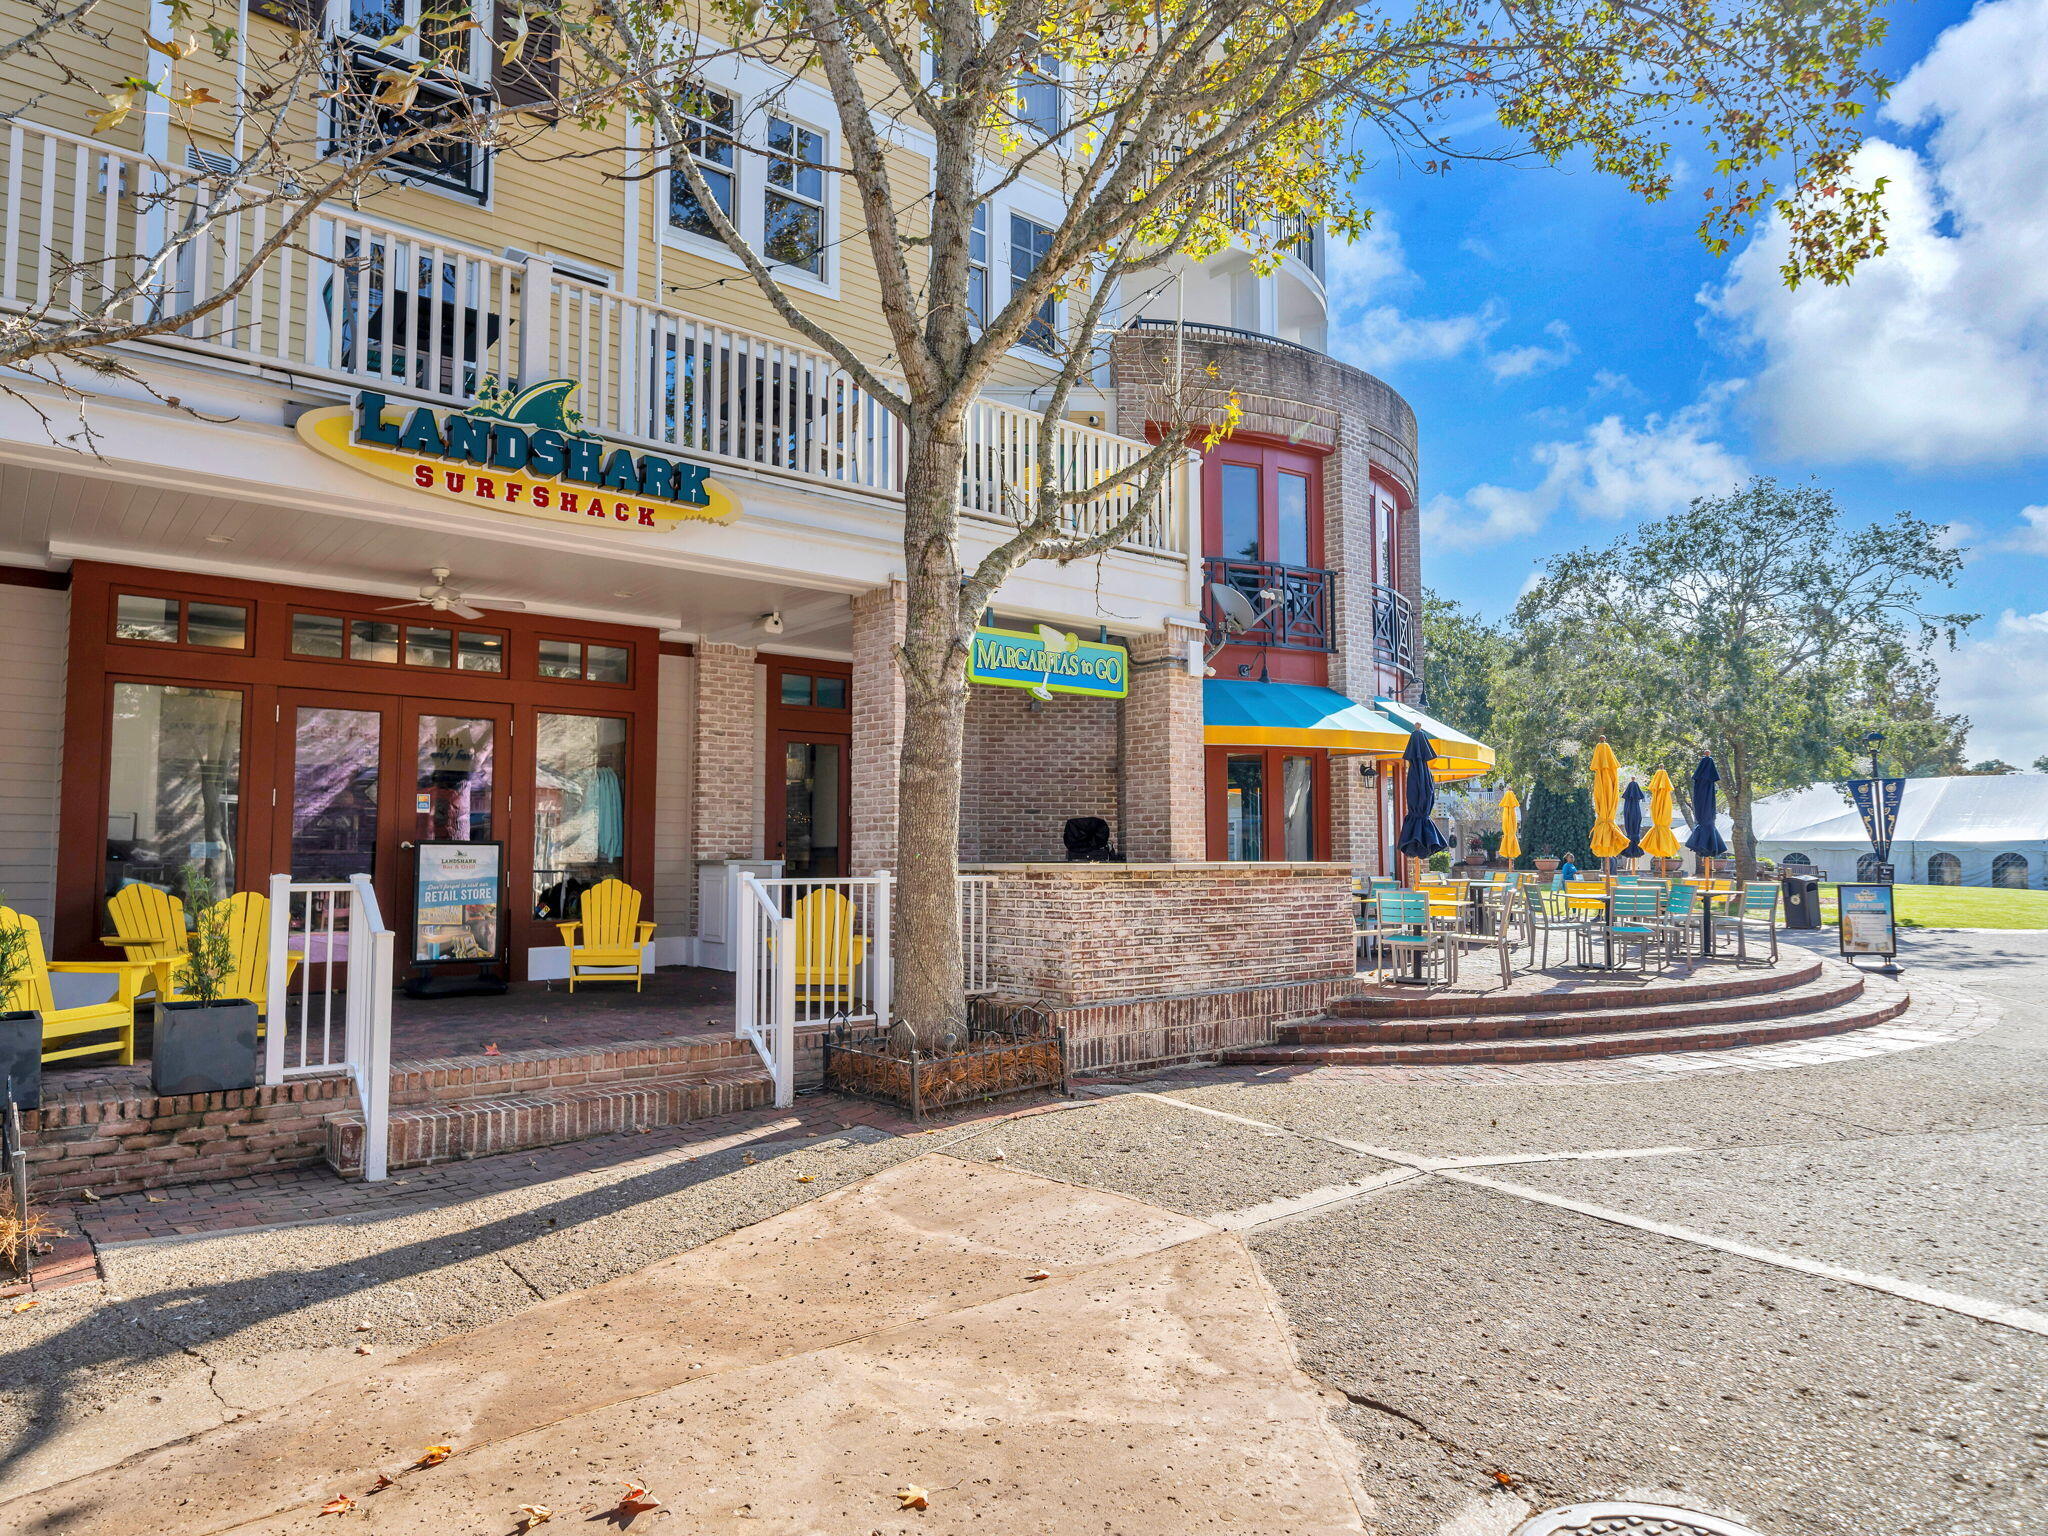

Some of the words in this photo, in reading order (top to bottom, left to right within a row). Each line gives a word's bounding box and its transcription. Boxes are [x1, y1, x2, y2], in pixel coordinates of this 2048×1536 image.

[355, 390, 711, 506] LANDSHARK
[414, 464, 656, 527] SURFSHACK
[1081, 659, 1094, 675] to
[1095, 657, 1122, 684] GO
[424, 890, 459, 903] RETAIL
[460, 888, 492, 901] STORE
